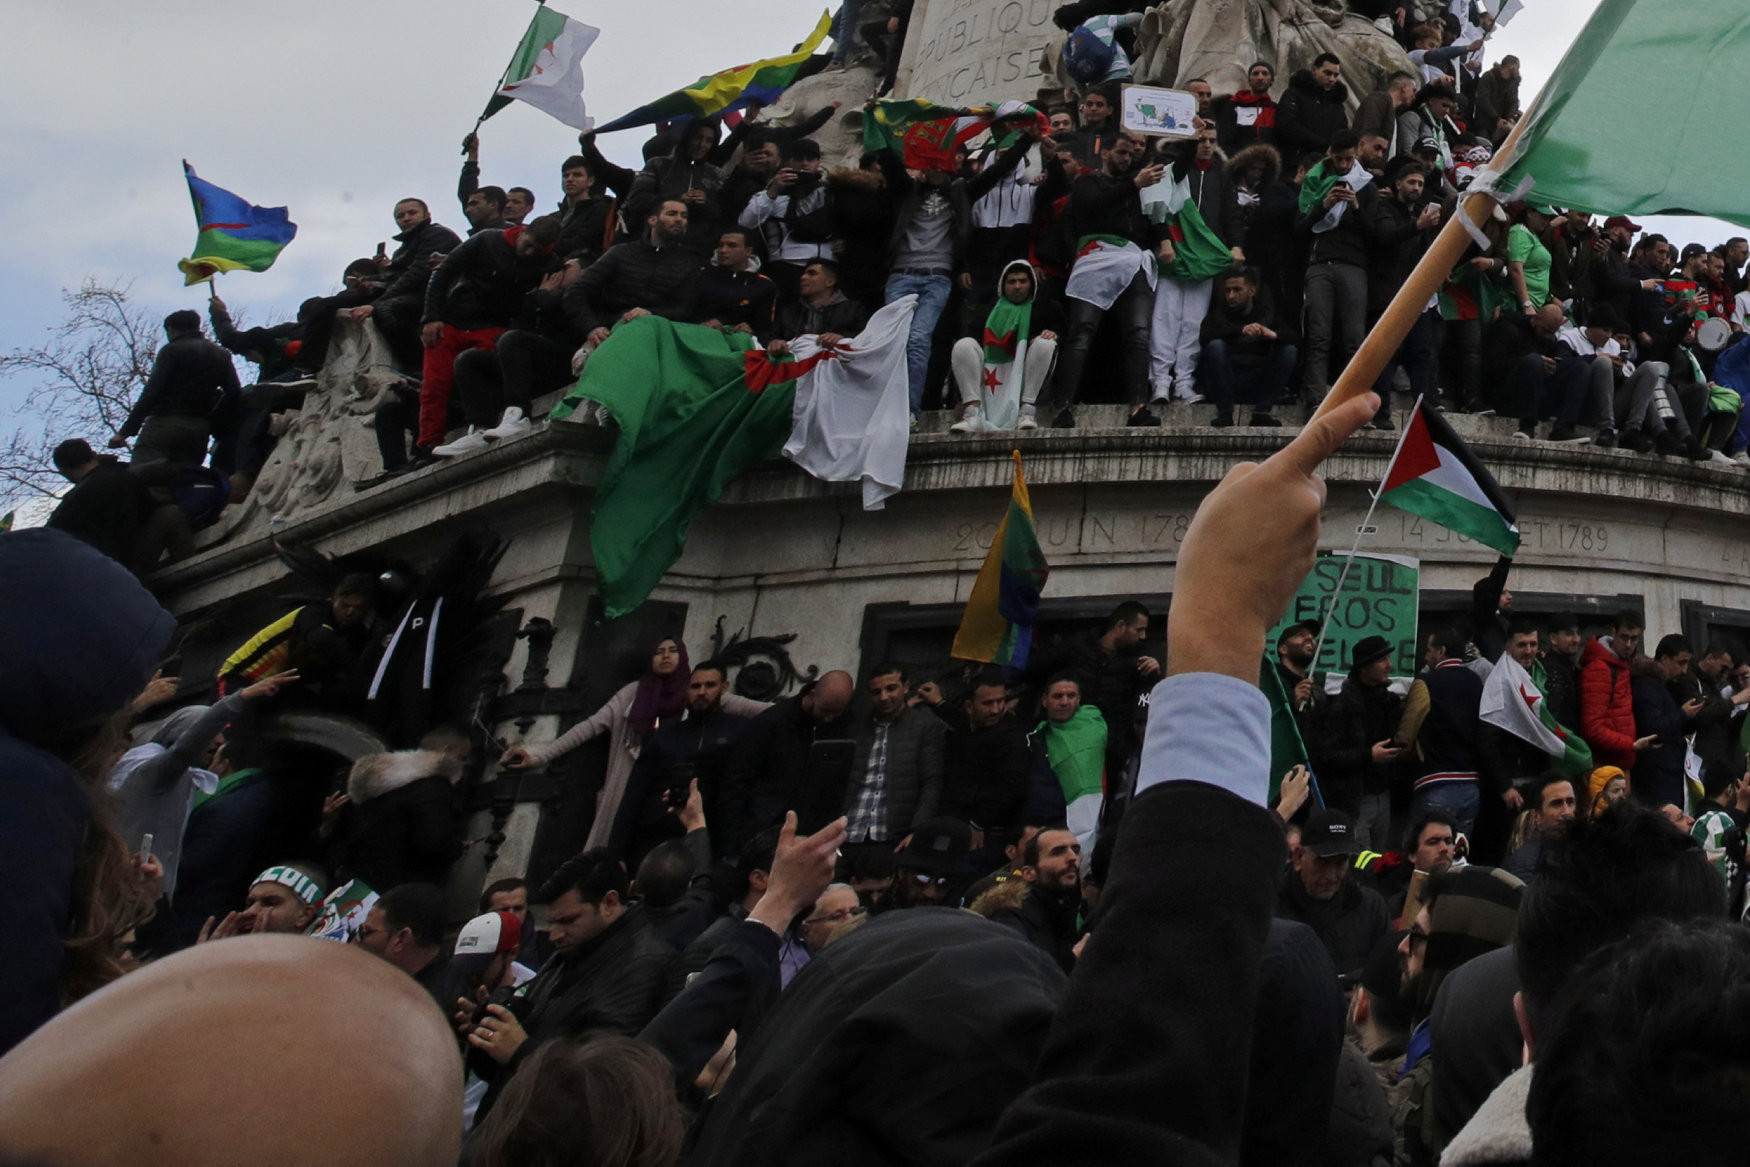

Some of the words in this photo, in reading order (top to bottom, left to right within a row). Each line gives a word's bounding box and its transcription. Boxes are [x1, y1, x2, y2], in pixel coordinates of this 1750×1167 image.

[1141, 514, 1189, 544] 178
[1559, 522, 1609, 552] 1789
[1314, 560, 1412, 596] SEUL
[1277, 594, 1398, 632] EROS
